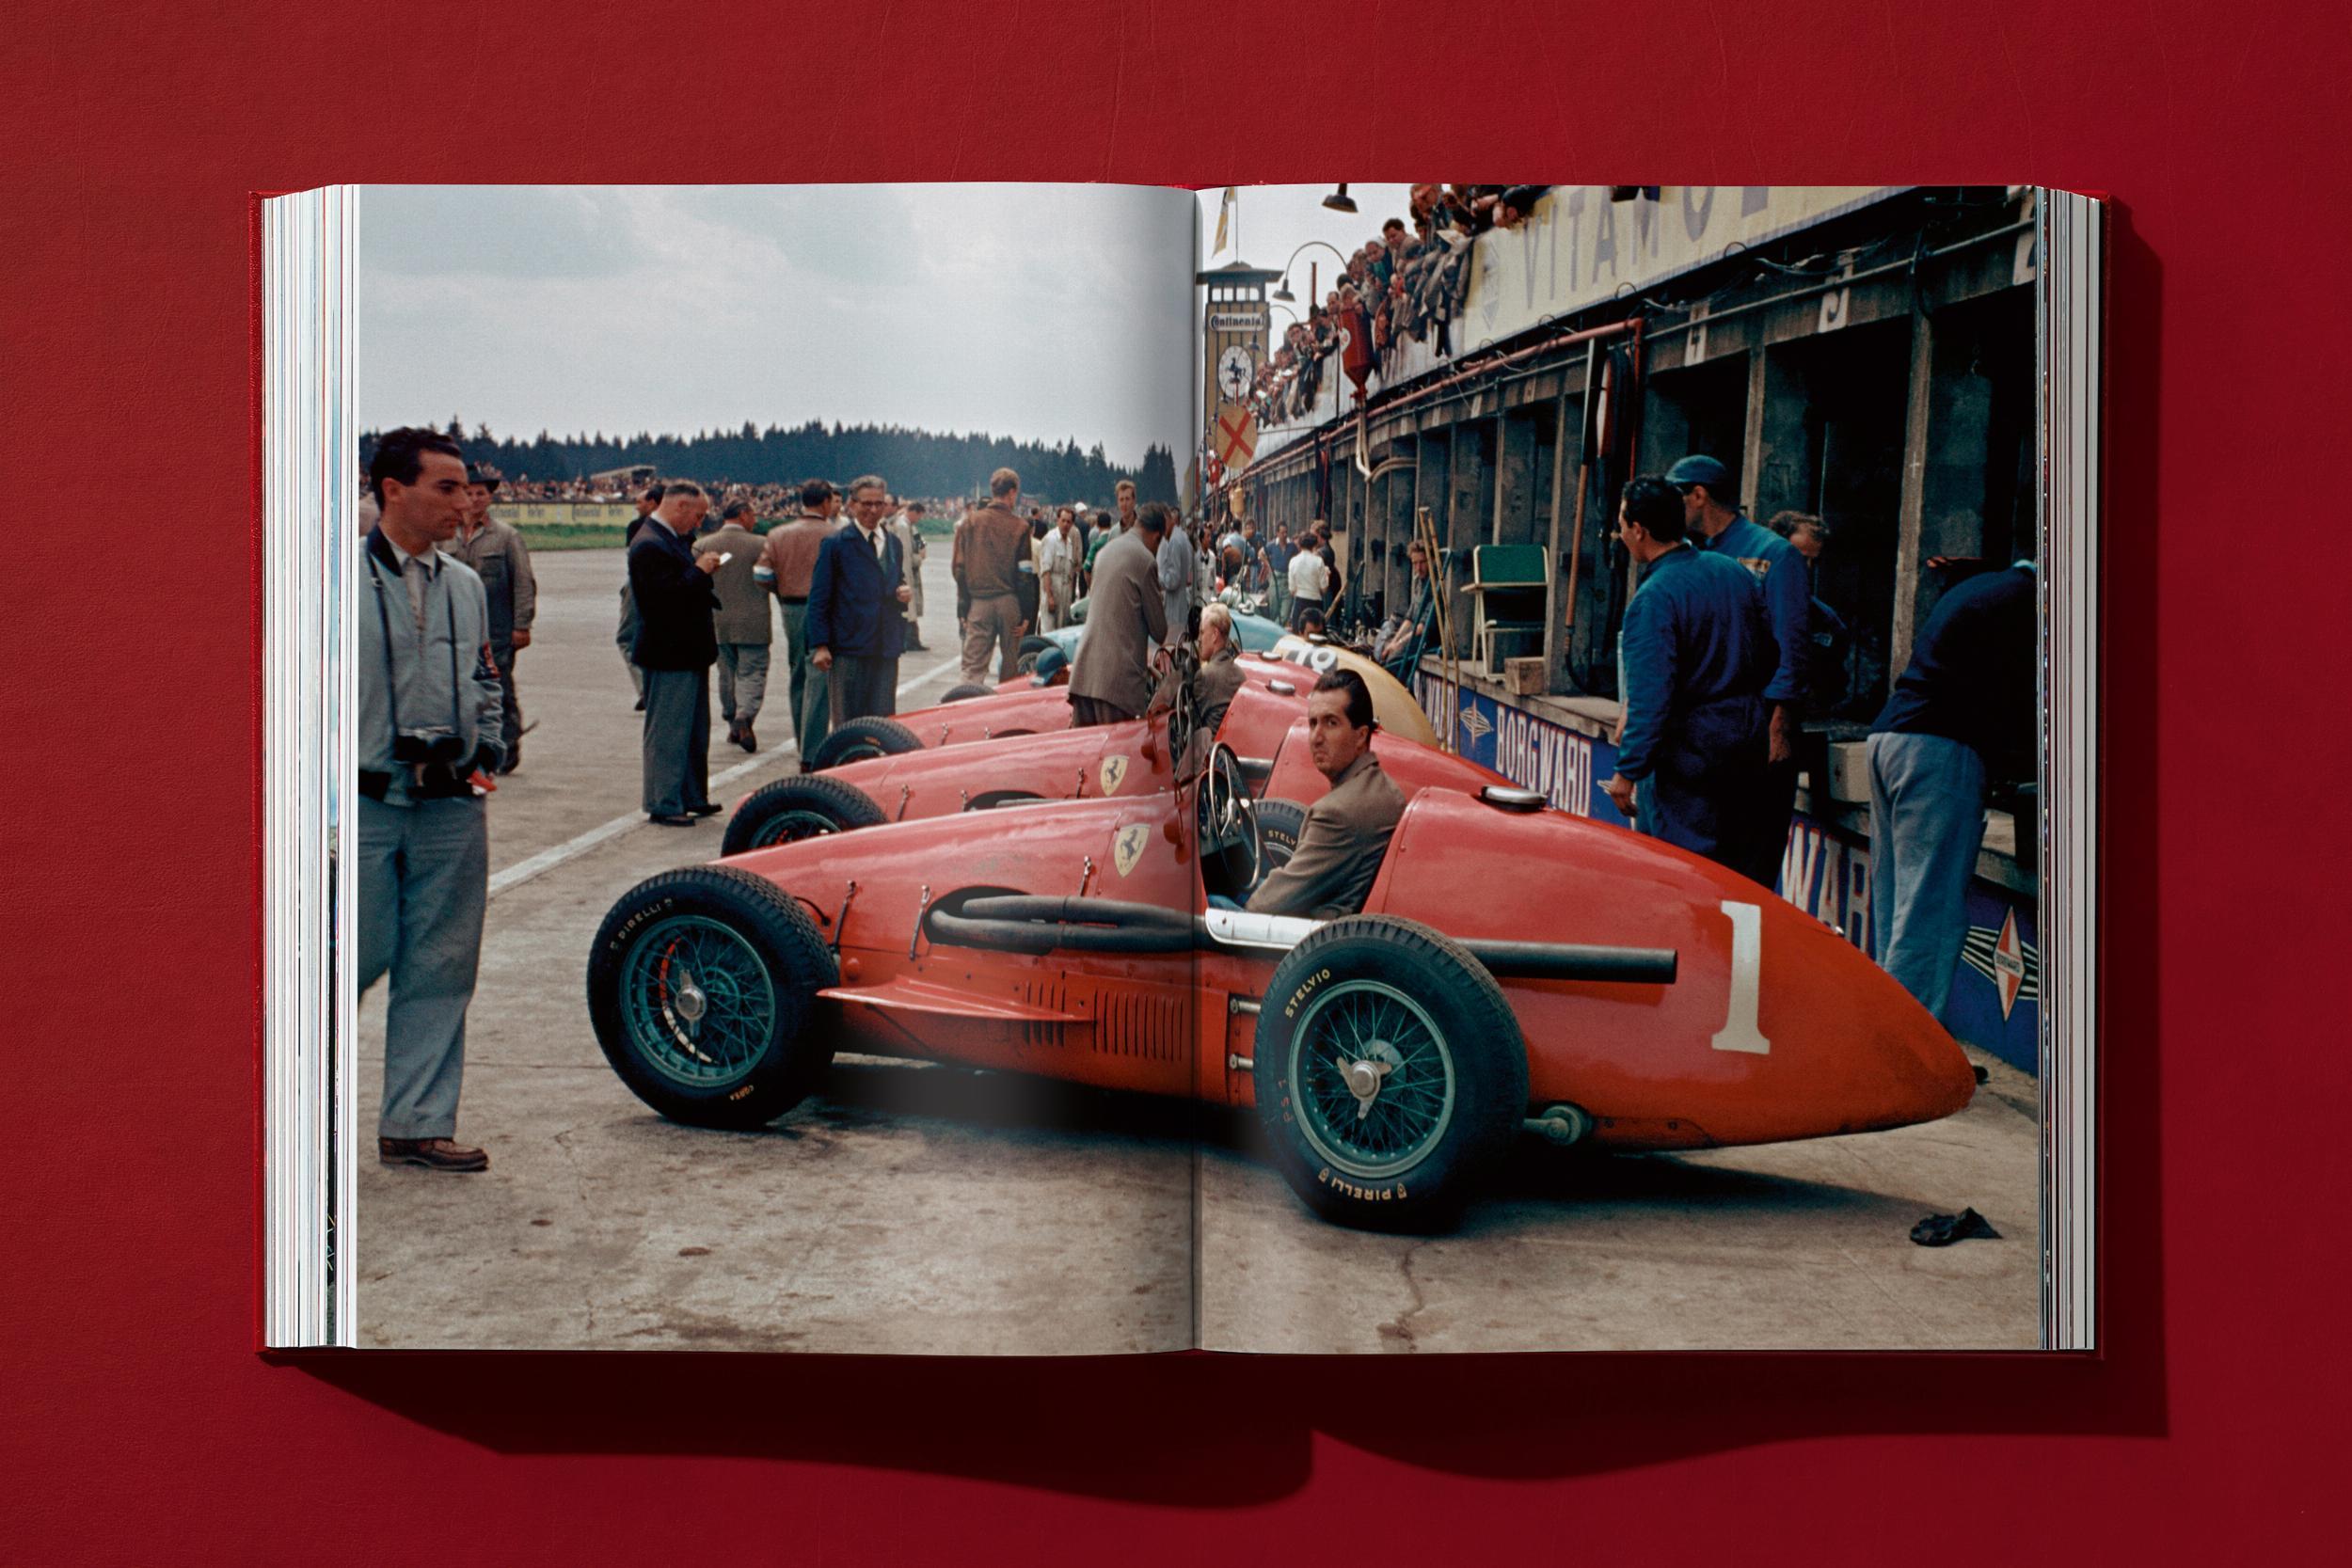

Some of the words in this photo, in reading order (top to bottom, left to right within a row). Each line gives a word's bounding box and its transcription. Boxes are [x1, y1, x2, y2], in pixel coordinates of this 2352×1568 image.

[1523, 186, 1770, 309] VITAMO
[1495, 705, 1593, 818] BORGWARD
[617, 903, 661, 940] PIRELLI
[1284, 968, 1331, 1019] STELVIO
[1711, 899, 1771, 1055] 1
[1331, 1177, 1392, 1201] PIRELLI
